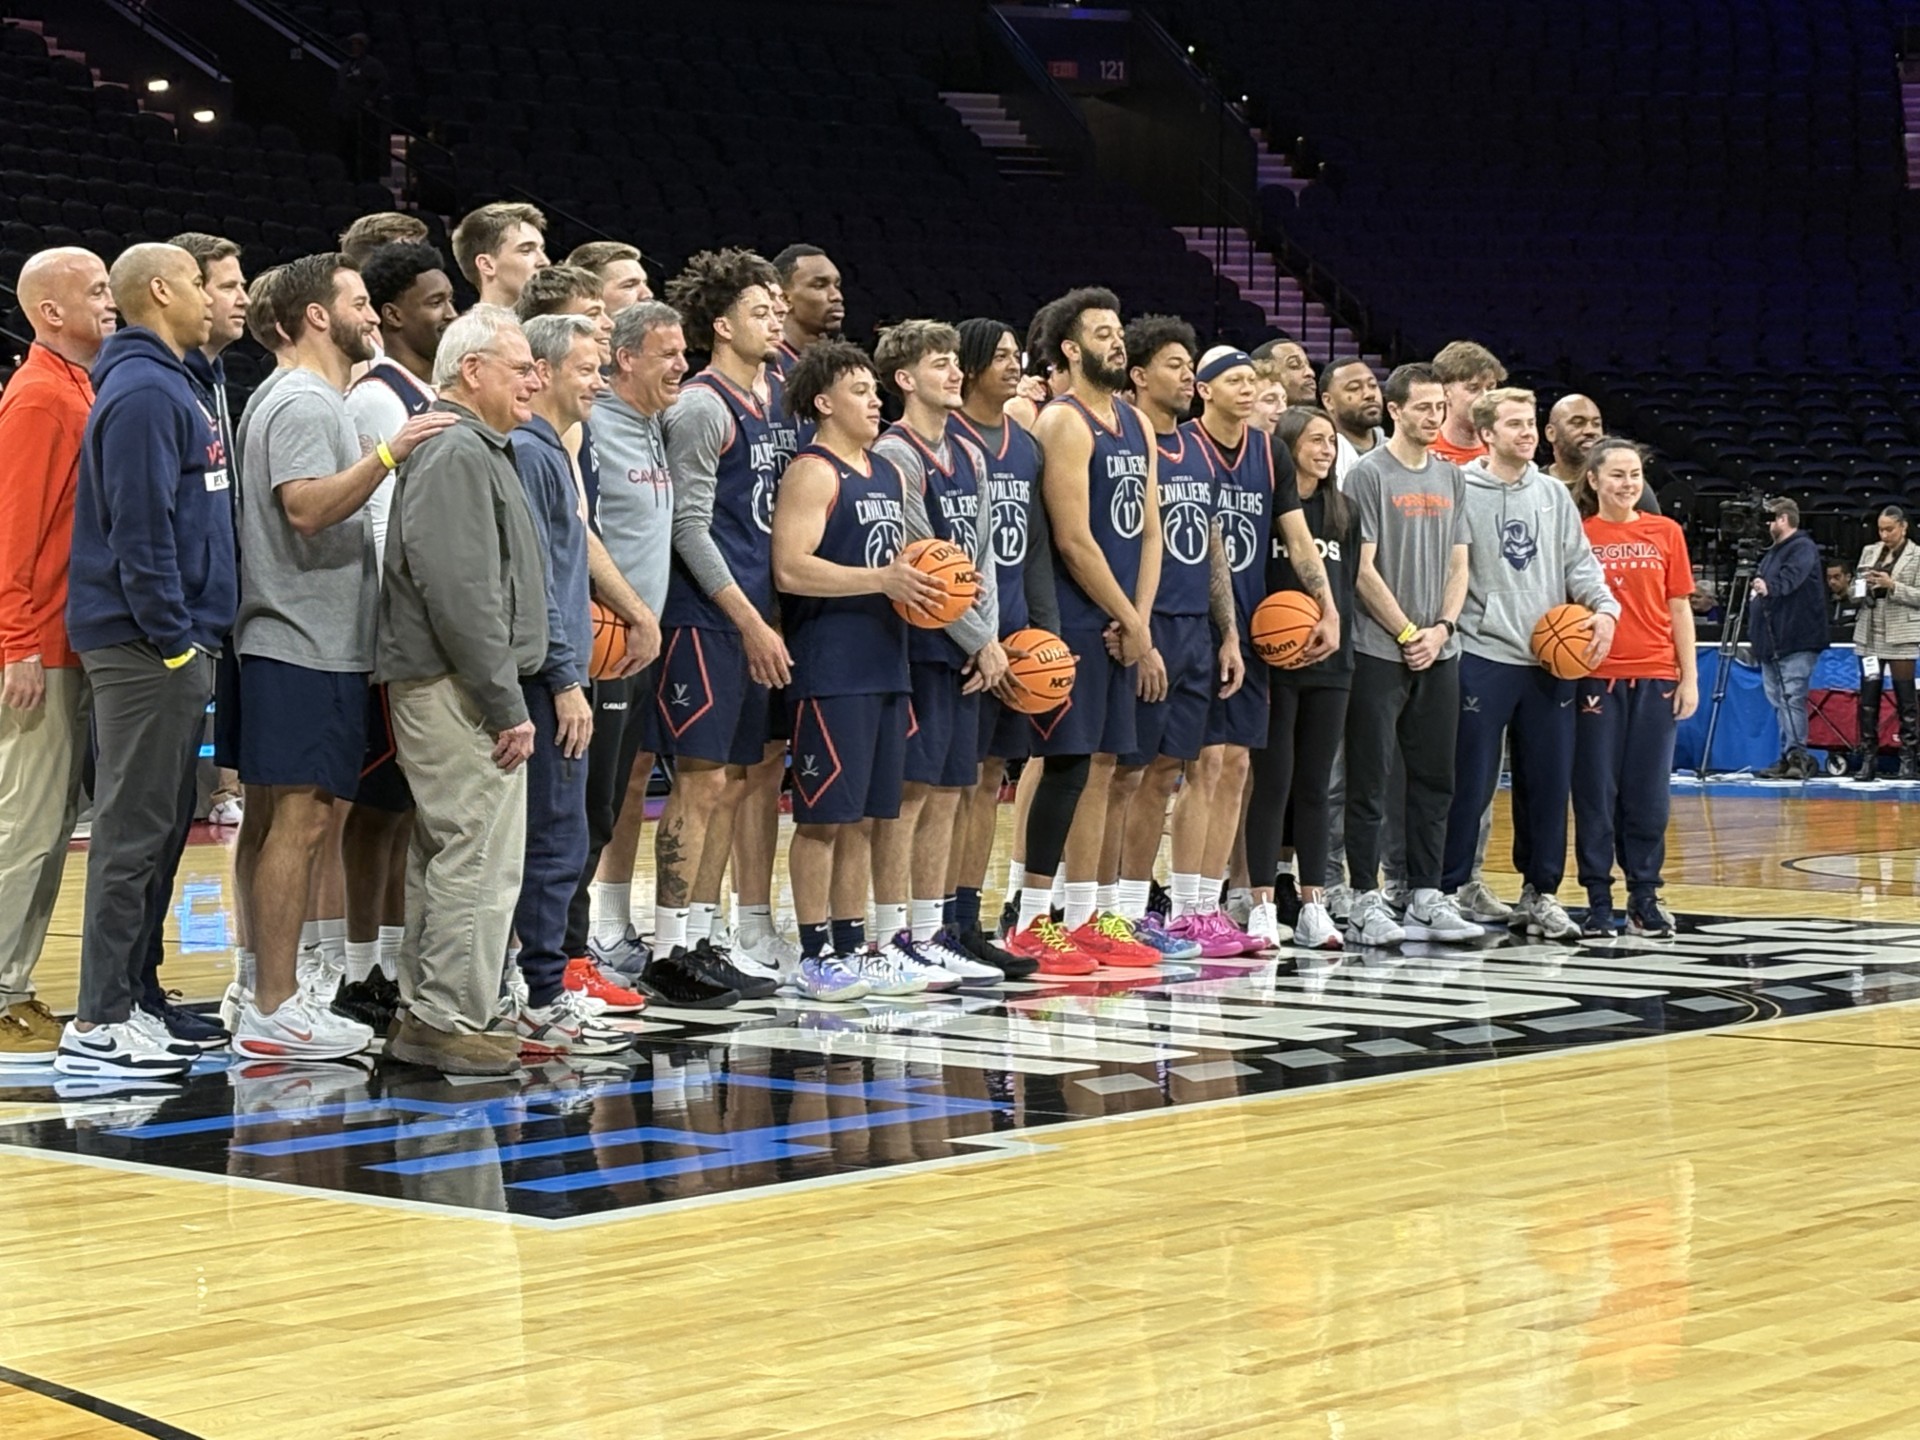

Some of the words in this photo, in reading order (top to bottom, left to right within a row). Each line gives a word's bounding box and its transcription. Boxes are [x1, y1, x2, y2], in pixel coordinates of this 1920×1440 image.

[1100, 60, 1124, 79] 121
[989, 480, 1030, 504] VALIERS
[1157, 482, 1211, 508] CAVALIERS
[1217, 489, 1263, 516] ALIERS
[855, 500, 903, 525] CAVALIER
[1123, 501, 1136, 530] 11
[1000, 527, 1019, 556] 12
[1186, 527, 1194, 555] 1
[1225, 535, 1236, 562] 6
[1272, 538, 1341, 561] HOS
[1591, 544, 1660, 559] RGINIA
